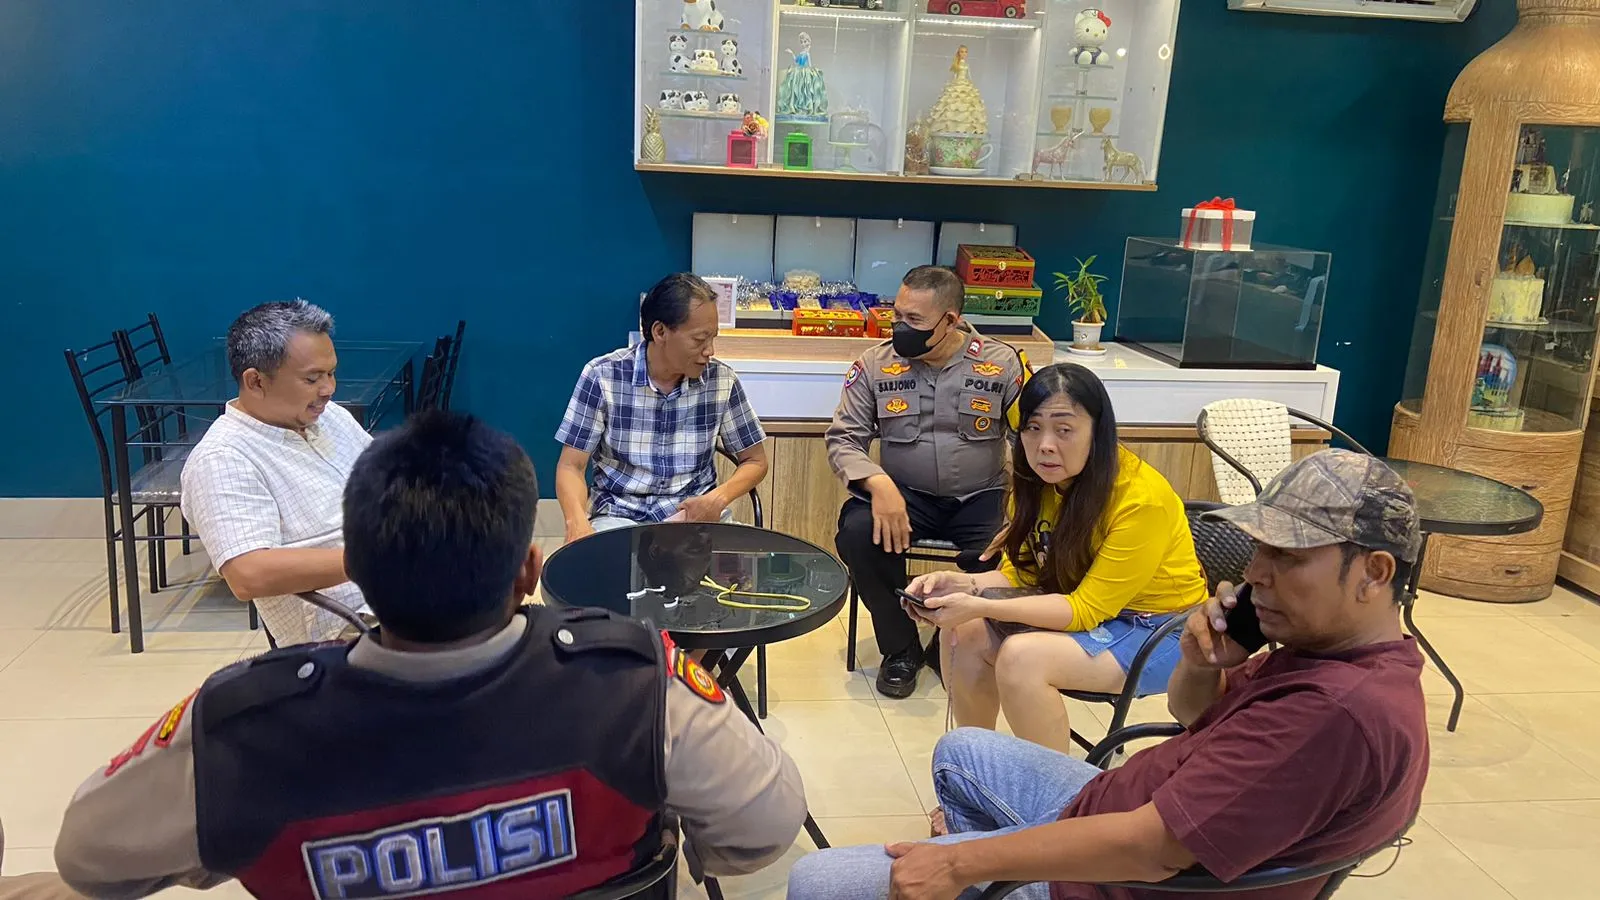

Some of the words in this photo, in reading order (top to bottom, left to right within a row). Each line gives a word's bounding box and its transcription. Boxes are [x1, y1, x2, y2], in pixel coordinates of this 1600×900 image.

[878, 379, 917, 393] SARJONO
[964, 378, 1004, 394] POLRI
[317, 799, 567, 899] POLISI
